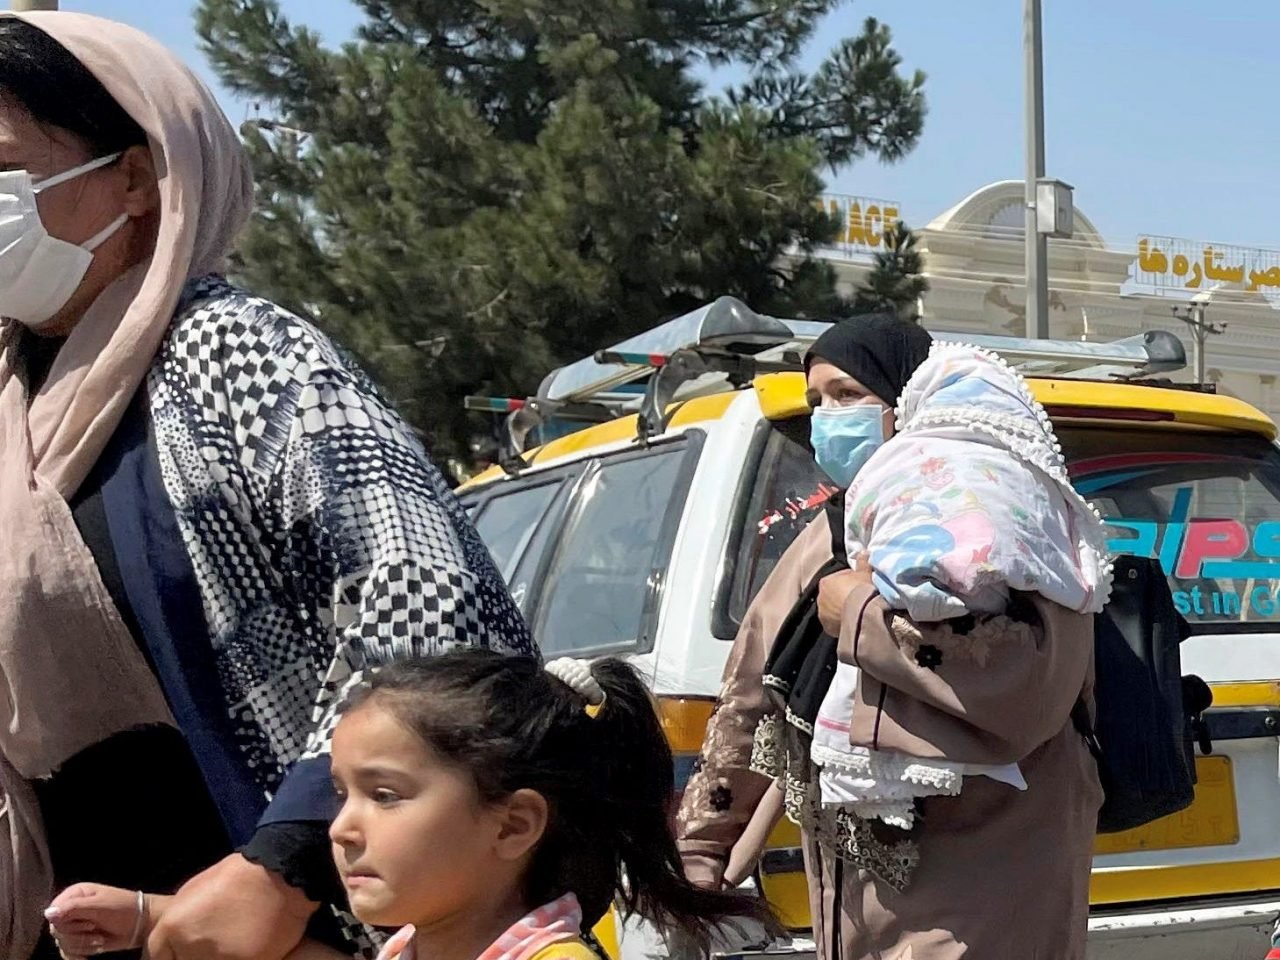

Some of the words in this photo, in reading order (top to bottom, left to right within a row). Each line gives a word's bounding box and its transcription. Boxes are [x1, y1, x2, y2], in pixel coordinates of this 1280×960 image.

[1138, 238, 1169, 274] ها
[1171, 245, 1245, 289] ستاره
[1213, 591, 1241, 616] in
